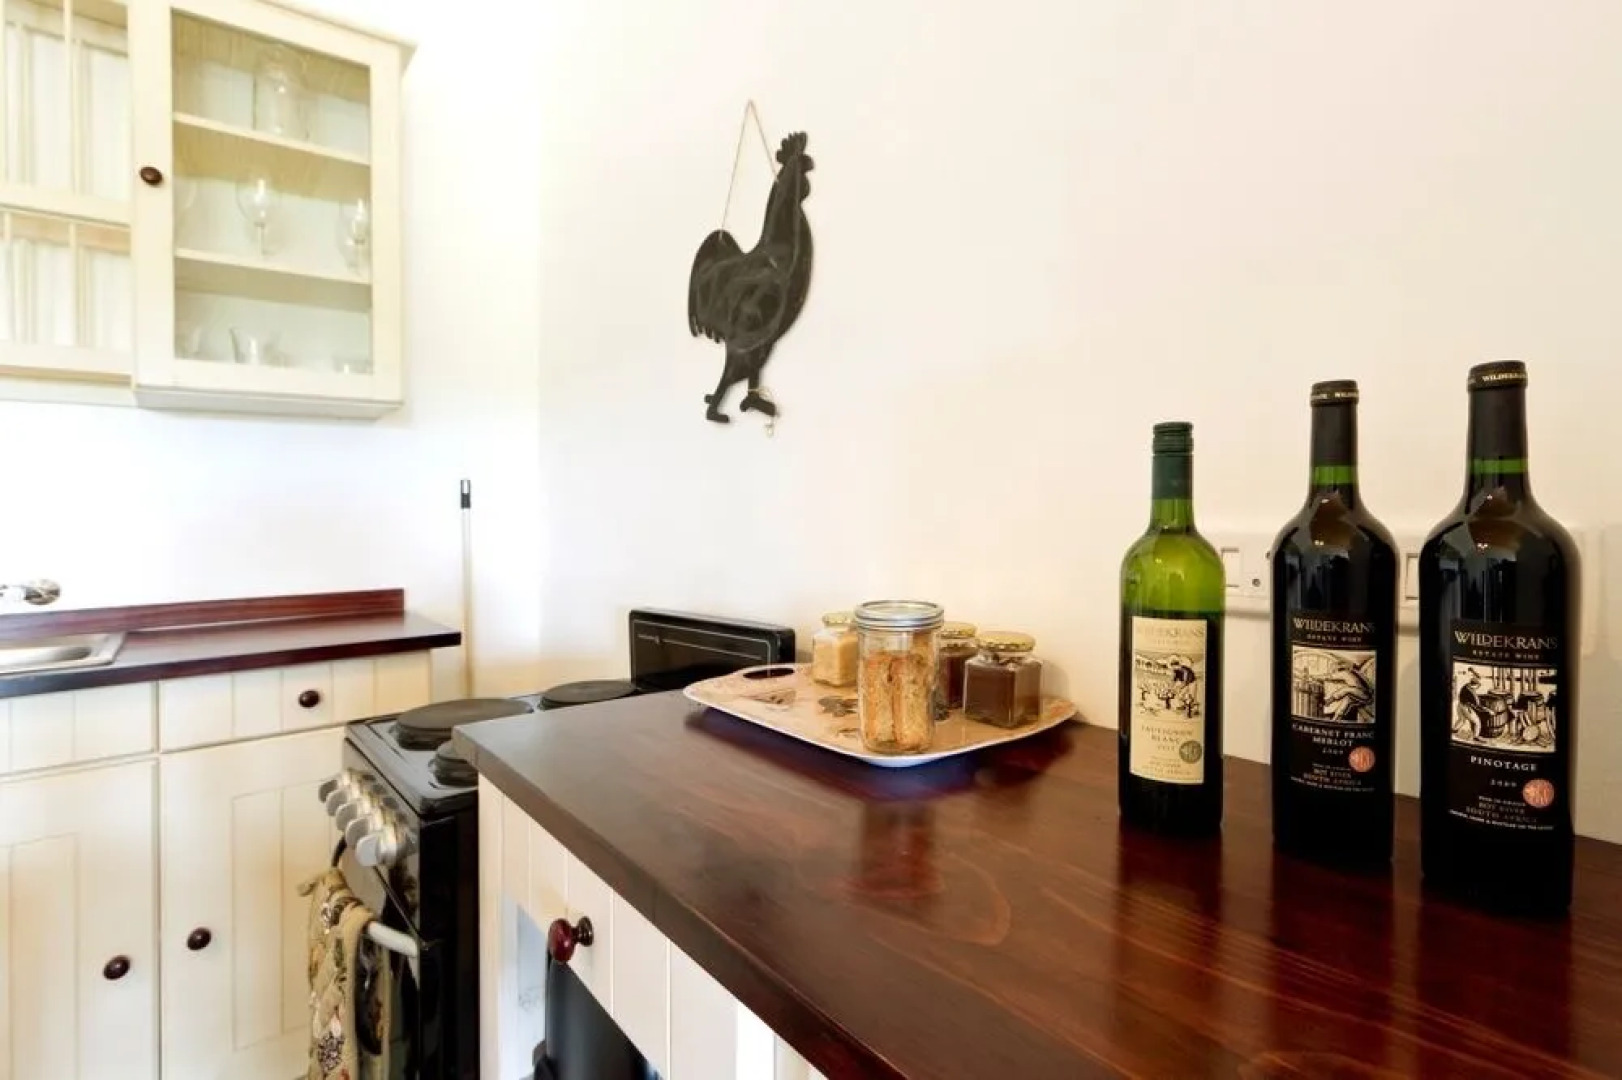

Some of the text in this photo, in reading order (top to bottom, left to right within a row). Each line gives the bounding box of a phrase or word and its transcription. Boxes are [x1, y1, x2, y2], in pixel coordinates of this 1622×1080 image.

[1454, 630, 1558, 650] WILDEKRANS
[1472, 649, 1510, 658] ESTATE
[1291, 723, 1374, 739] CABERNET FRANC
[1151, 734, 1180, 744] BLANC
[1312, 735, 1353, 746] MERLOT
[1470, 755, 1538, 771] PINOTAGE
